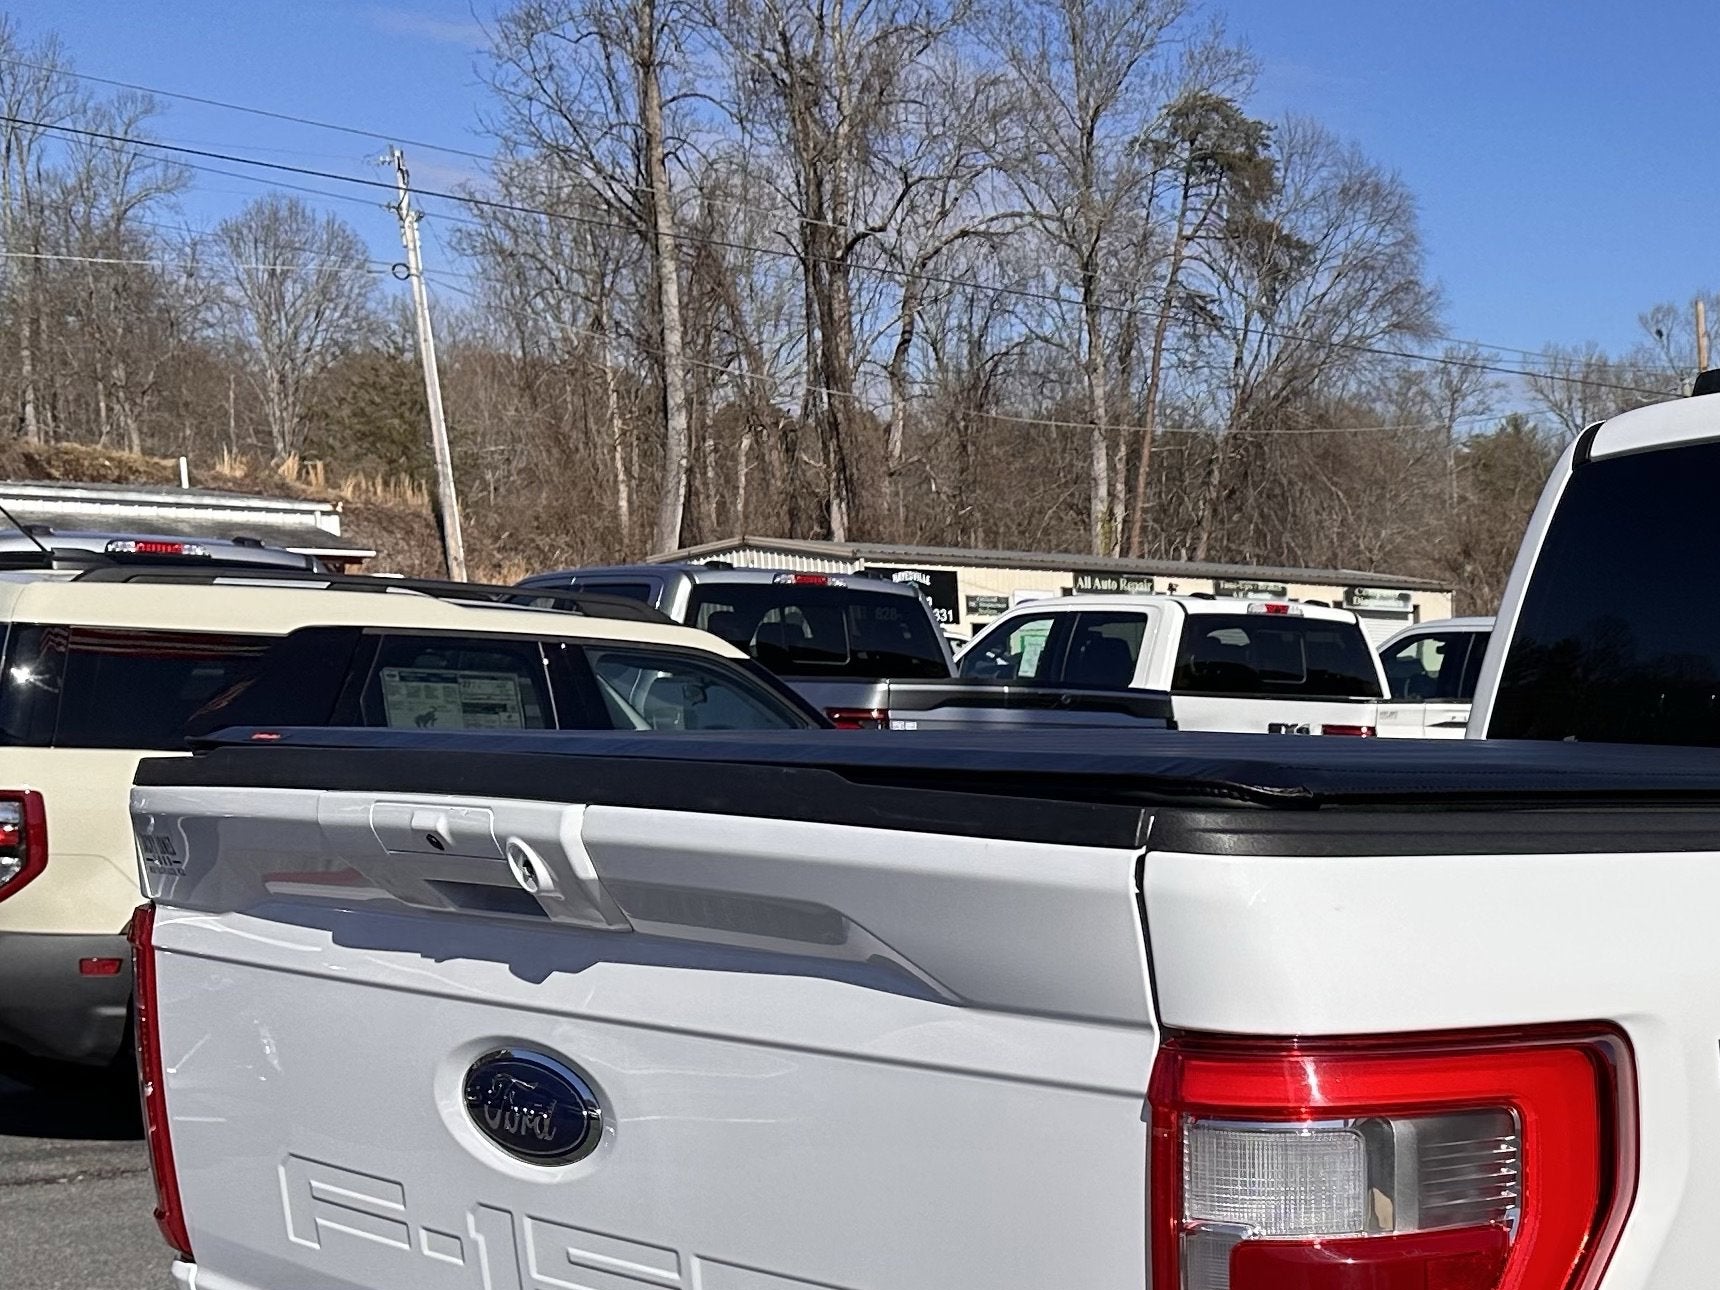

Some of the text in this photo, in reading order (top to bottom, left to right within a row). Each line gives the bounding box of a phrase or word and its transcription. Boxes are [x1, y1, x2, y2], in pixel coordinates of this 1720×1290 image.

[1077, 576, 1153, 593] All Auto Repair
